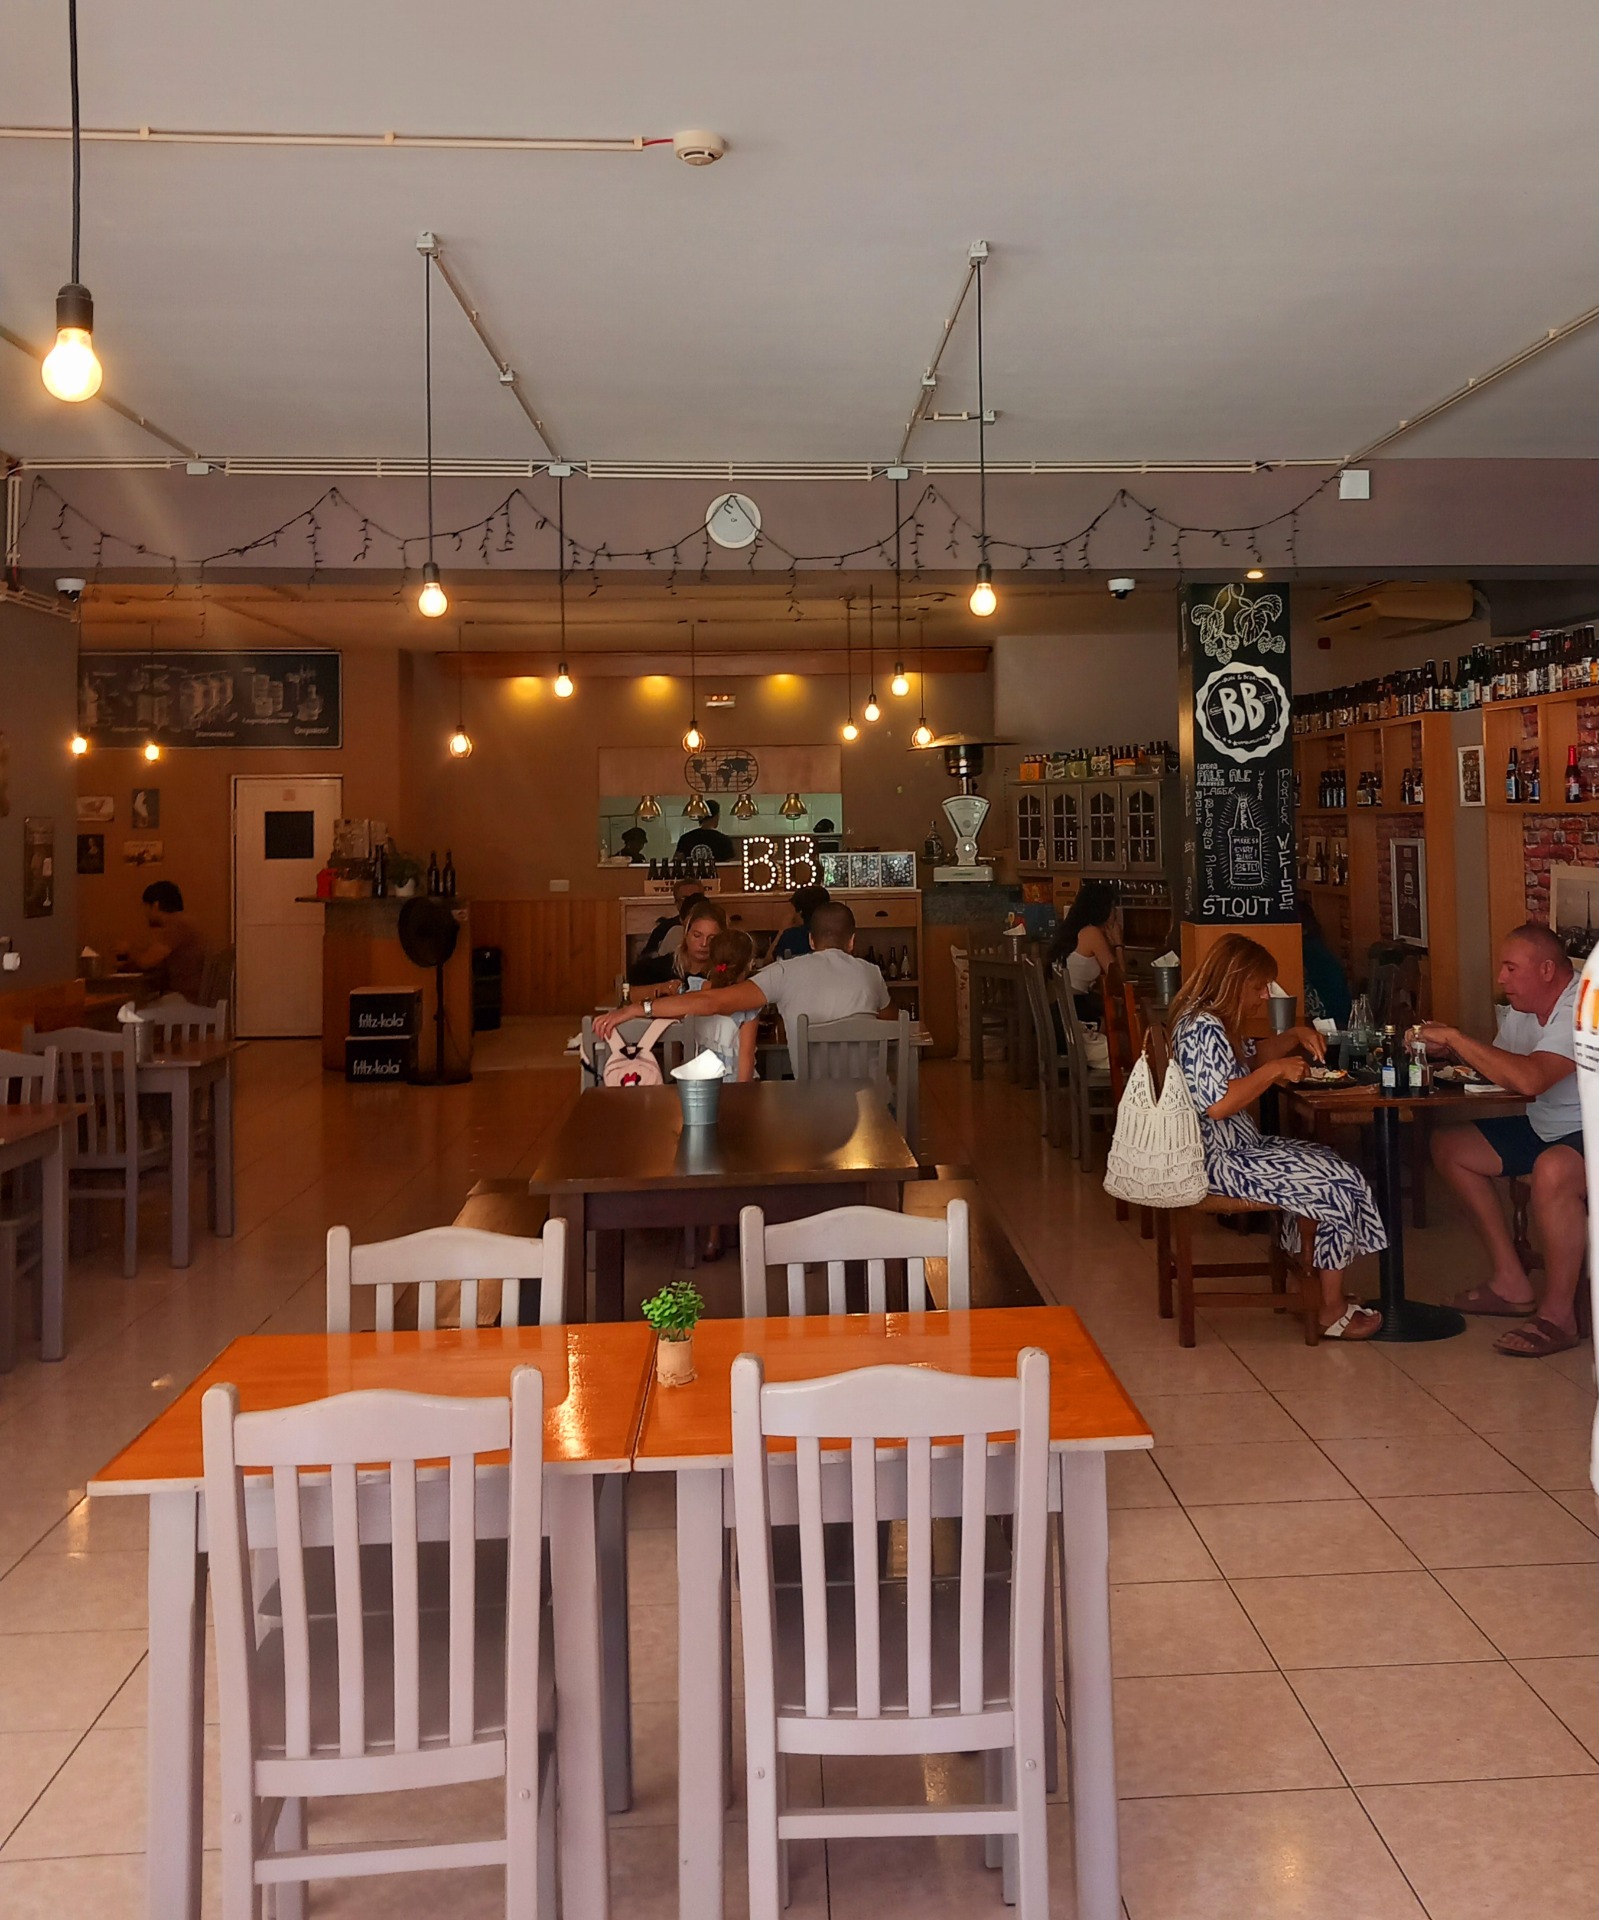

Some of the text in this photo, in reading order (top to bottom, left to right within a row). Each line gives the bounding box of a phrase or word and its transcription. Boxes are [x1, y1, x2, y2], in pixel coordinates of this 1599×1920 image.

[1218, 682, 1266, 736] BB
[1197, 769, 1252, 782] PALE ALE
[1203, 786, 1236, 796] LAGER
[1280, 768, 1291, 826] PORTER
[742, 834, 818, 891] BB
[1277, 832, 1295, 908] WEISS
[1202, 897, 1271, 916] STOUT
